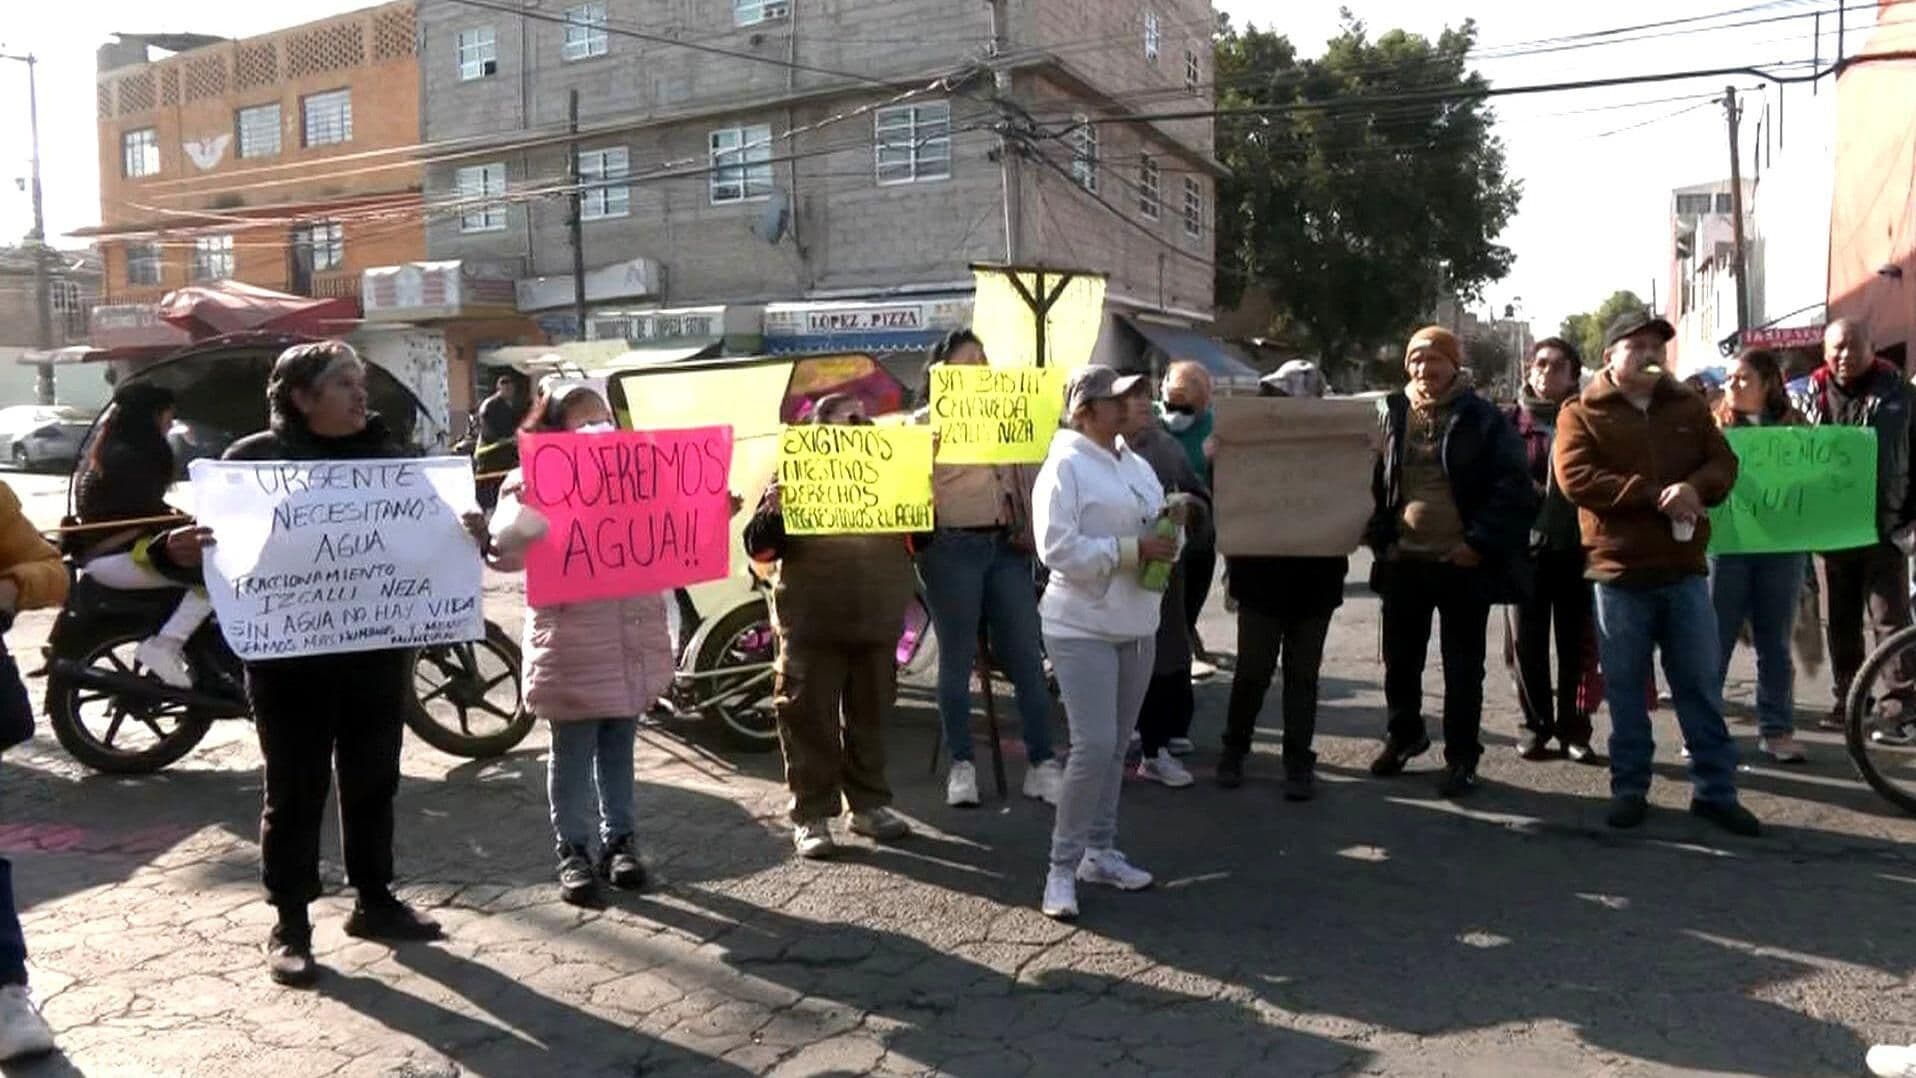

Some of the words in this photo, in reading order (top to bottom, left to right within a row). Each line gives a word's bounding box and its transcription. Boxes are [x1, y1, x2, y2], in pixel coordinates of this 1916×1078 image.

[871, 311, 918, 328] PIZZA
[783, 426, 893, 461] EXIGIMOS
[997, 418, 1034, 444] NEZA
[255, 463, 417, 495] URGENTE
[532, 438, 727, 508] QUEREMOS
[783, 484, 879, 508] DERECHOS
[877, 508, 894, 528] EL
[895, 504, 931, 527] AGUA
[314, 528, 386, 564] AGUA
[562, 509, 700, 577] AGUA!!
[231, 563, 396, 599] FRACCIONAMIENTO
[256, 586, 357, 616] IZCALLI
[379, 577, 432, 598] NEZA
[228, 619, 270, 640] SIN
[283, 610, 336, 632] AGUA
[343, 606, 367, 624] NO
[374, 602, 415, 622] HAY
[427, 596, 475, 618] VIDA
